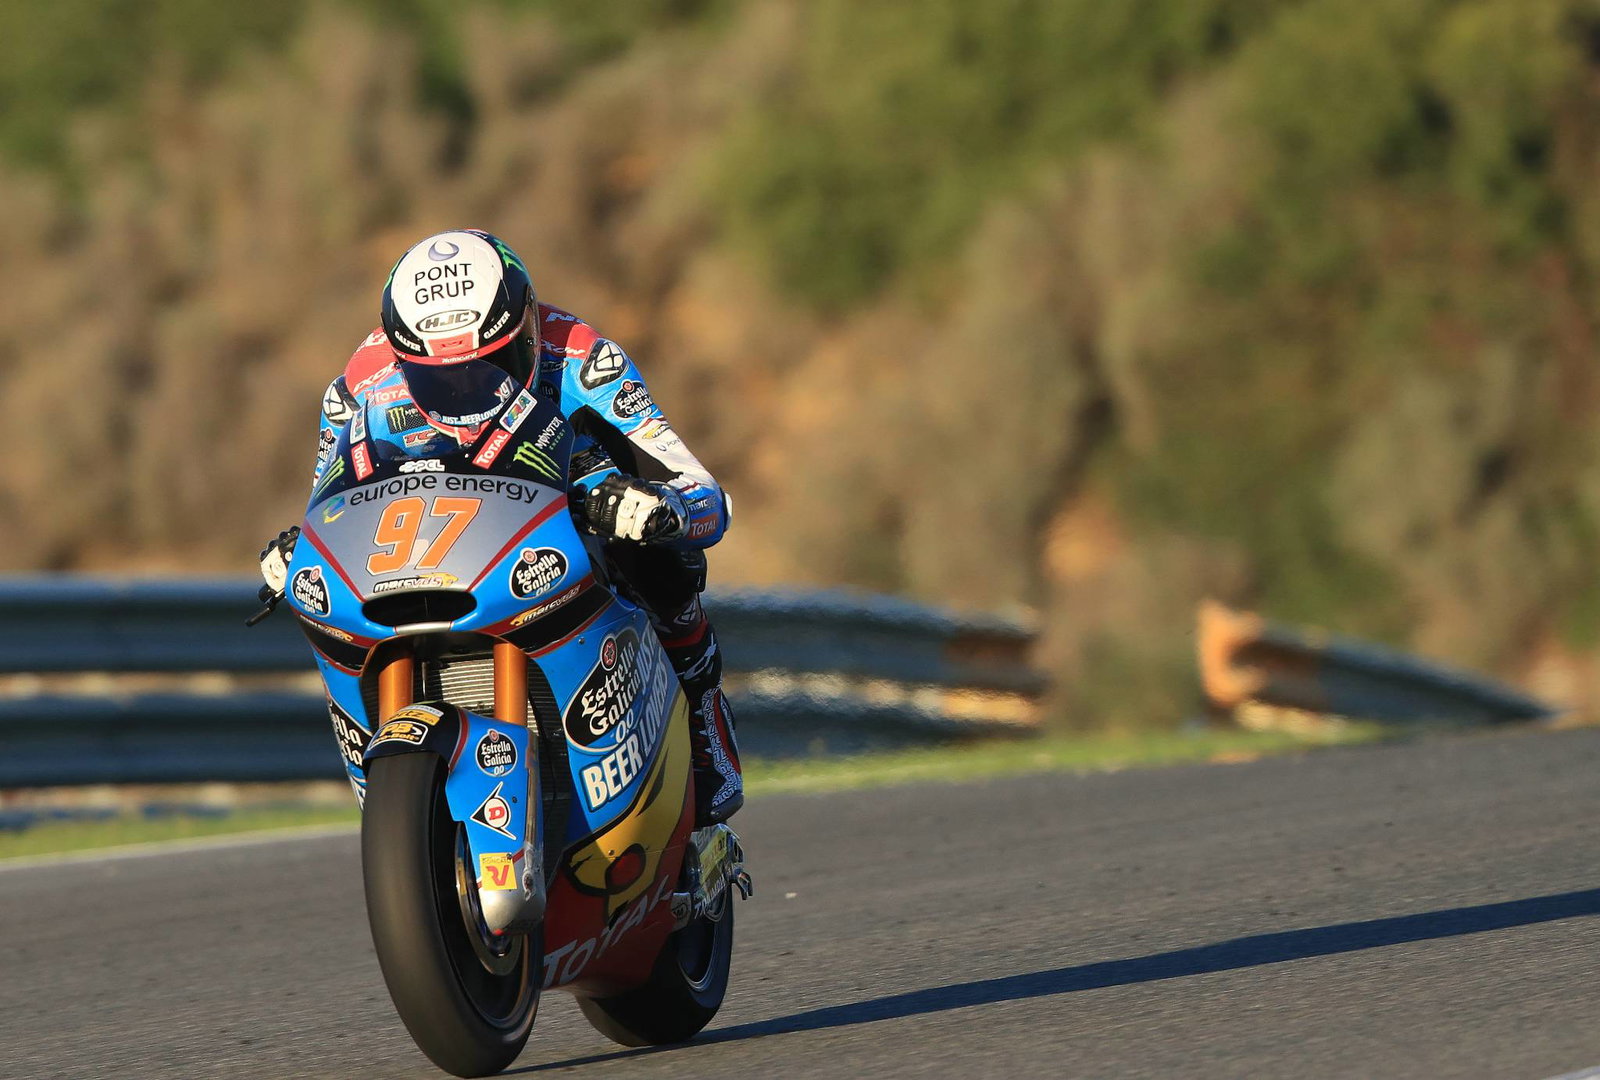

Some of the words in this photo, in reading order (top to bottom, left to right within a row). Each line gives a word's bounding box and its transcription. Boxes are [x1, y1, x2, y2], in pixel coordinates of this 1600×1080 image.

[414, 263, 472, 286] PONT
[415, 280, 475, 305] GRUP
[424, 310, 470, 329] HJC
[374, 388, 409, 402] TOTA
[534, 416, 563, 450] MONSTER
[354, 444, 368, 478] TOTAL
[476, 433, 508, 465] TOTAL
[350, 475, 437, 506] europe
[445, 477, 539, 503] energy
[366, 496, 484, 577] 97
[516, 553, 558, 585] Estrella
[522, 566, 562, 593] Galicia
[581, 641, 635, 718] Estrella
[589, 667, 641, 736] Galicia
[481, 742, 511, 757] Estrella
[483, 753, 512, 769] Galicia
[583, 734, 643, 808] BEER
[488, 806, 505, 820] D
[543, 875, 673, 988] TOTAL
